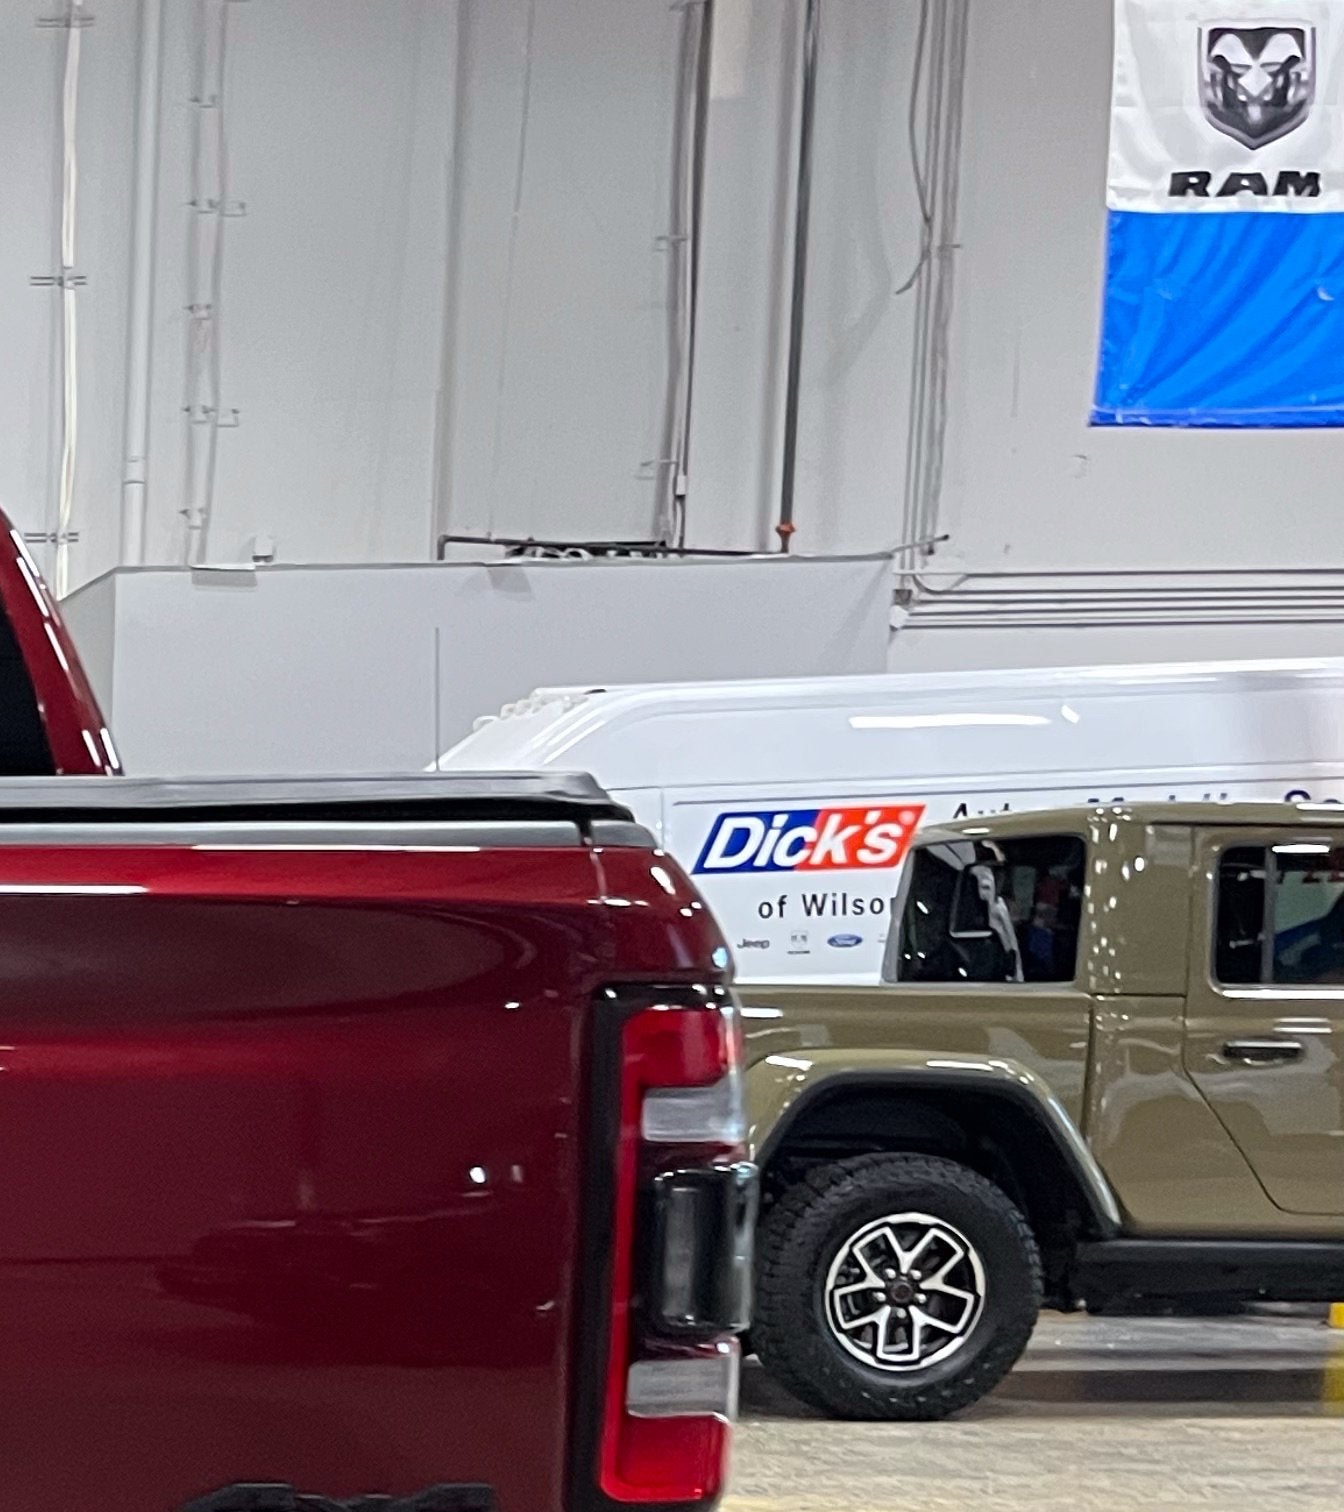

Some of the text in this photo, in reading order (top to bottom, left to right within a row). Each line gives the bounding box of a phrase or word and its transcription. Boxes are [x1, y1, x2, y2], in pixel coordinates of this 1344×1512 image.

[1168, 170, 1320, 198] RAM
[703, 810, 904, 869] Dick's
[758, 892, 895, 918] of Wilso
